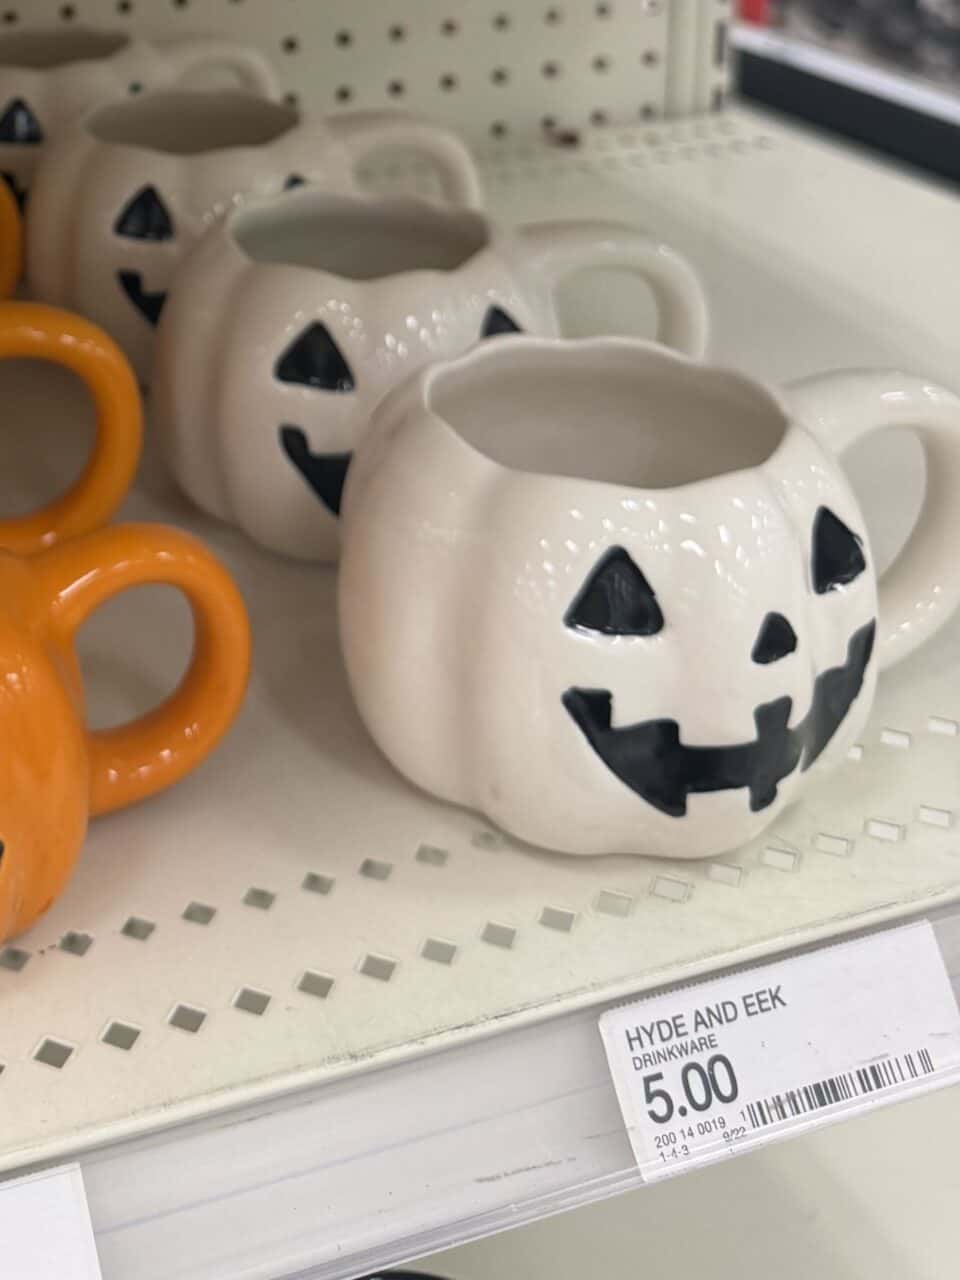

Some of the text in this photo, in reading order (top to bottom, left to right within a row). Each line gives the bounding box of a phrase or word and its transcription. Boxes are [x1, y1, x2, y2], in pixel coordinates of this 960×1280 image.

[625, 985, 787, 1052] HYDE AND EEK
[632, 1033, 718, 1071] DRINKWARE
[642, 1054, 739, 1124] 5.00
[654, 1131, 677, 1149] 200
[680, 1126, 694, 1140] 14
[696, 1116, 726, 1136] 0019
